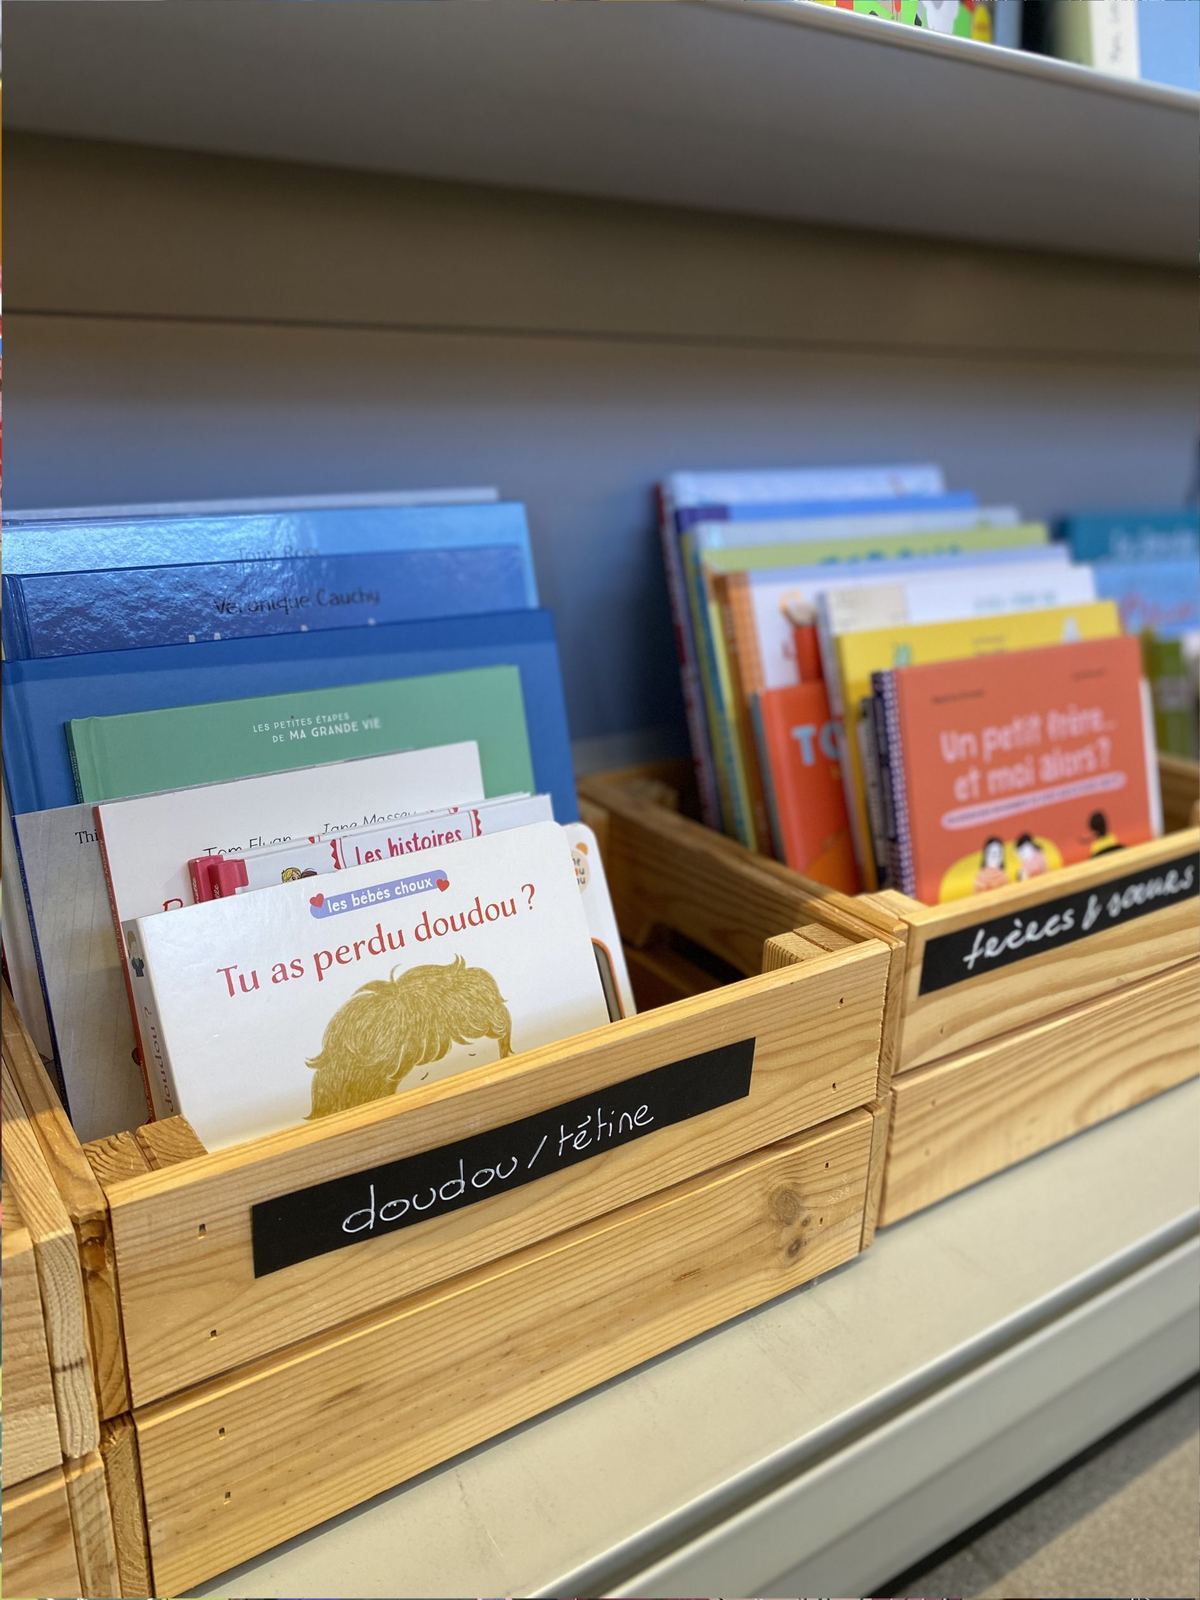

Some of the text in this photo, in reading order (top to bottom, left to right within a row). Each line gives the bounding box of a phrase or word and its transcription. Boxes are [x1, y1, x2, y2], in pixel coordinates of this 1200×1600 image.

[316, 587, 381, 607] Cauchy
[252, 711, 351, 733] LES PETITES ÉTAPES
[271, 716, 382, 743] DE MA GRANDE VIE
[939, 730, 978, 763] Un
[981, 712, 1041, 764] petit
[953, 765, 981, 802] et
[986, 752, 1036, 795] moi
[74, 828, 100, 845] Thi
[387, 829, 463, 858] histoires
[326, 876, 433, 913] les bébés choux
[216, 965, 260, 998] Tu
[271, 957, 305, 985] as
[313, 922, 406, 982] perdu
[414, 896, 518, 943] doudou
